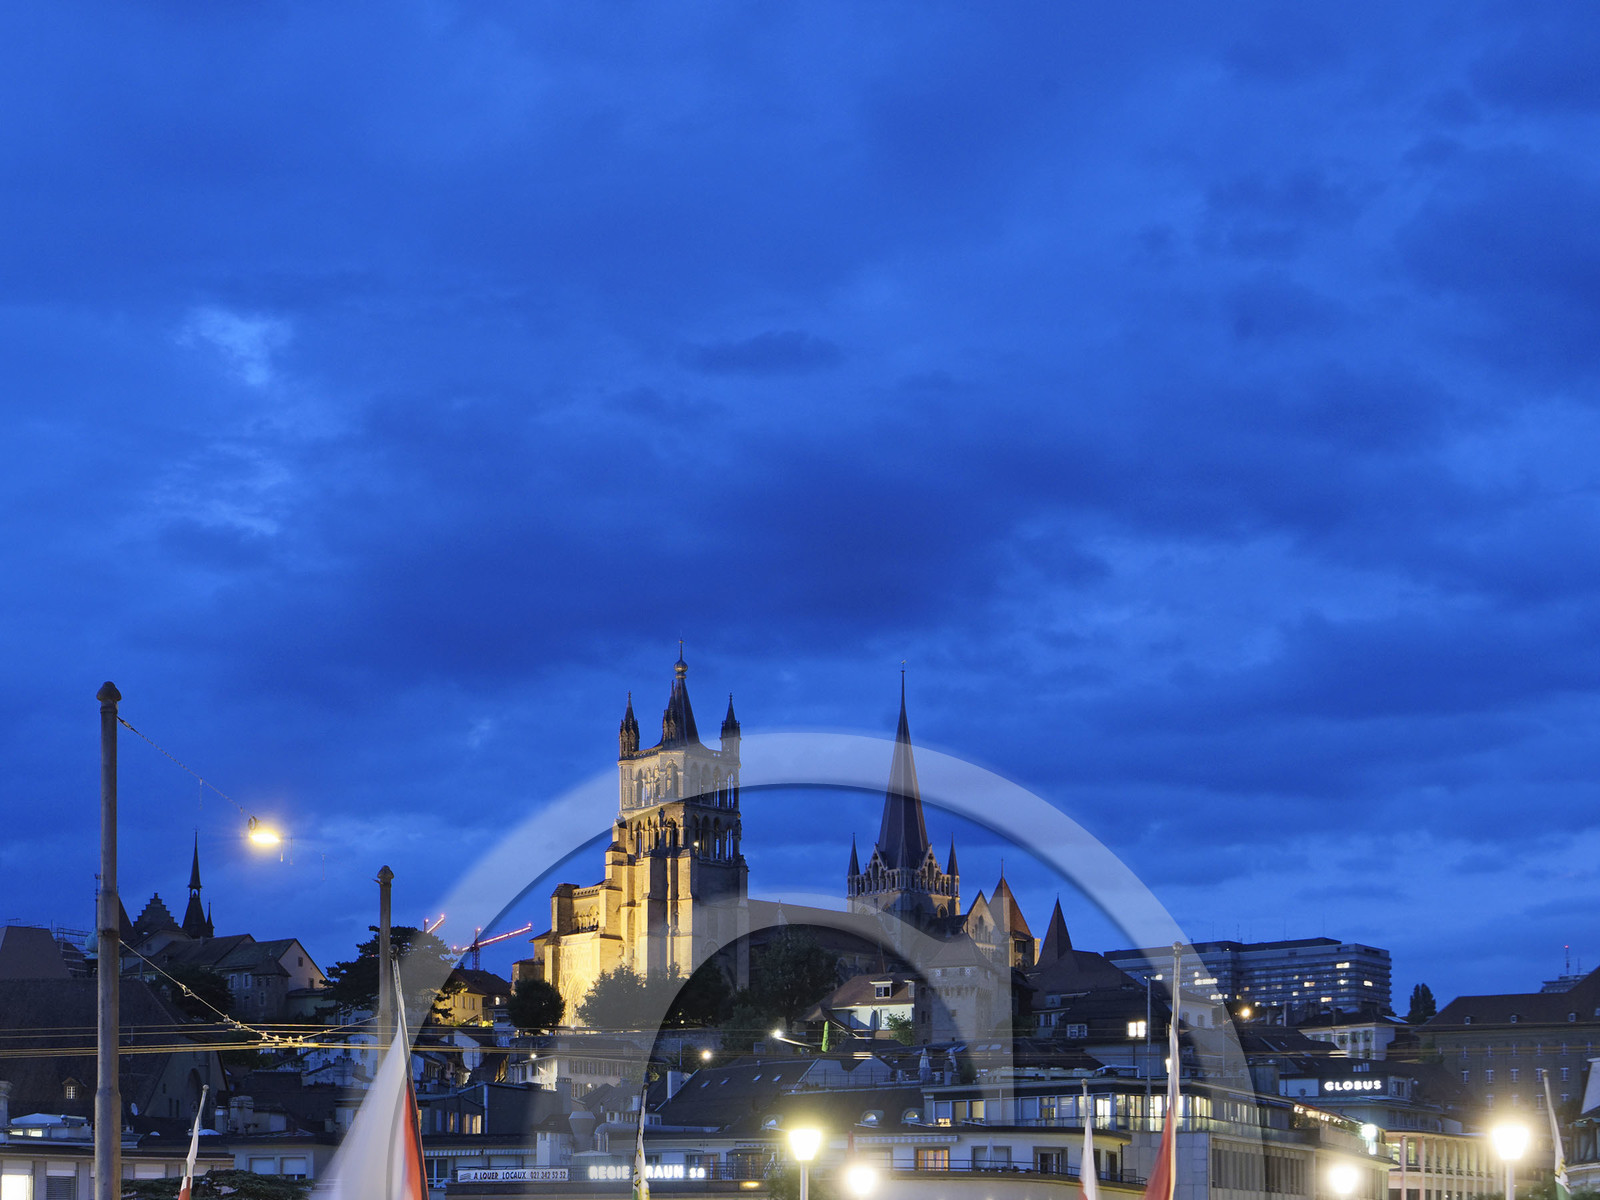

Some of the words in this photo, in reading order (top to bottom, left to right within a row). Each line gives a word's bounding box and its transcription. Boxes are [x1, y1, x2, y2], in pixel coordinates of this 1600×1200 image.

[1324, 1080, 1382, 1091] GLOBUS
[480, 1172, 499, 1180] LOUER
[502, 1171, 527, 1180] LOCAUX
[644, 1165, 684, 1179] RAUN
